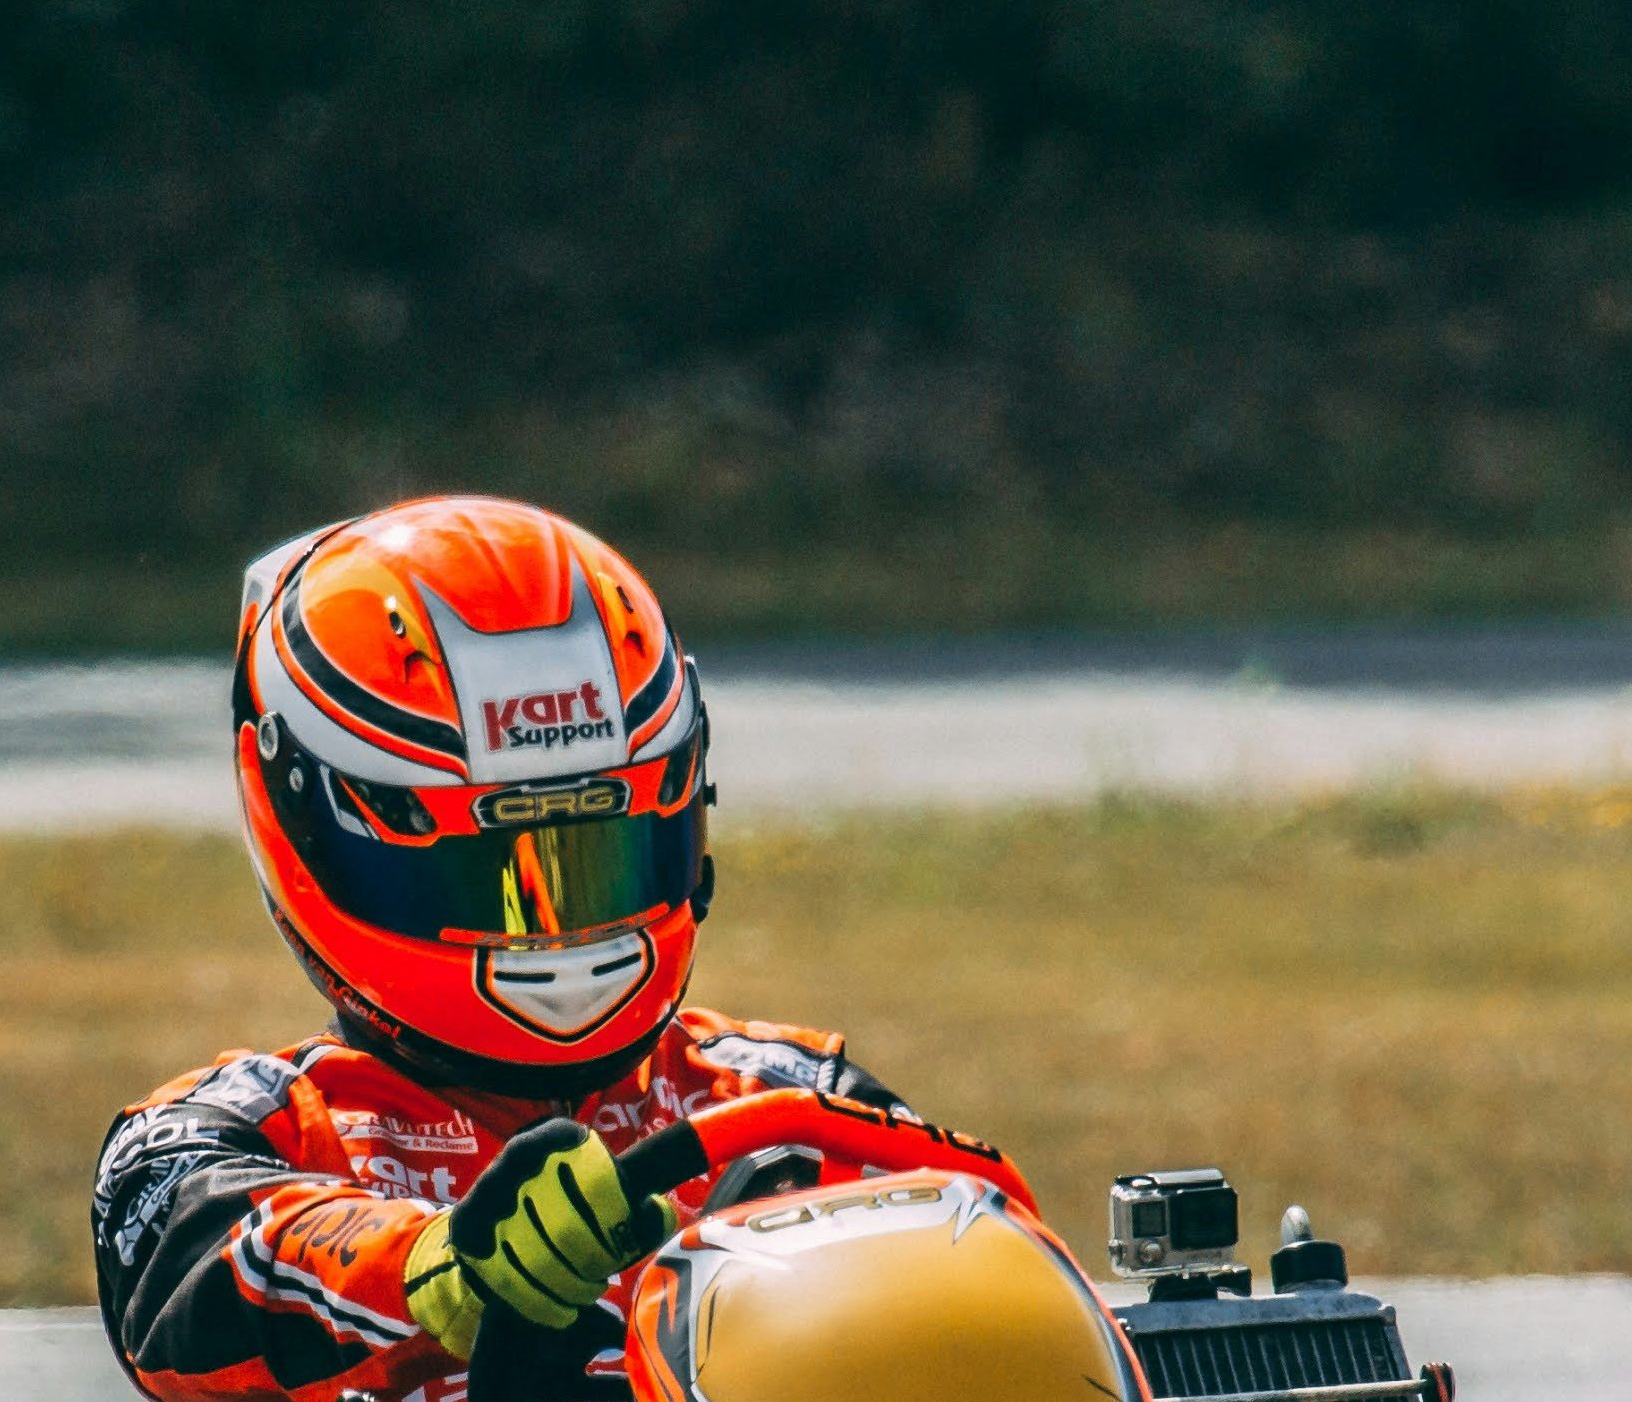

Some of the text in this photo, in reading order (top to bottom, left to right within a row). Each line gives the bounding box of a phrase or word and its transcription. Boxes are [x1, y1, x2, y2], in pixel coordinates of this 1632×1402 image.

[481, 680, 605, 752] Kart
[507, 718, 615, 749] Support
[493, 786, 615, 822] CRG
